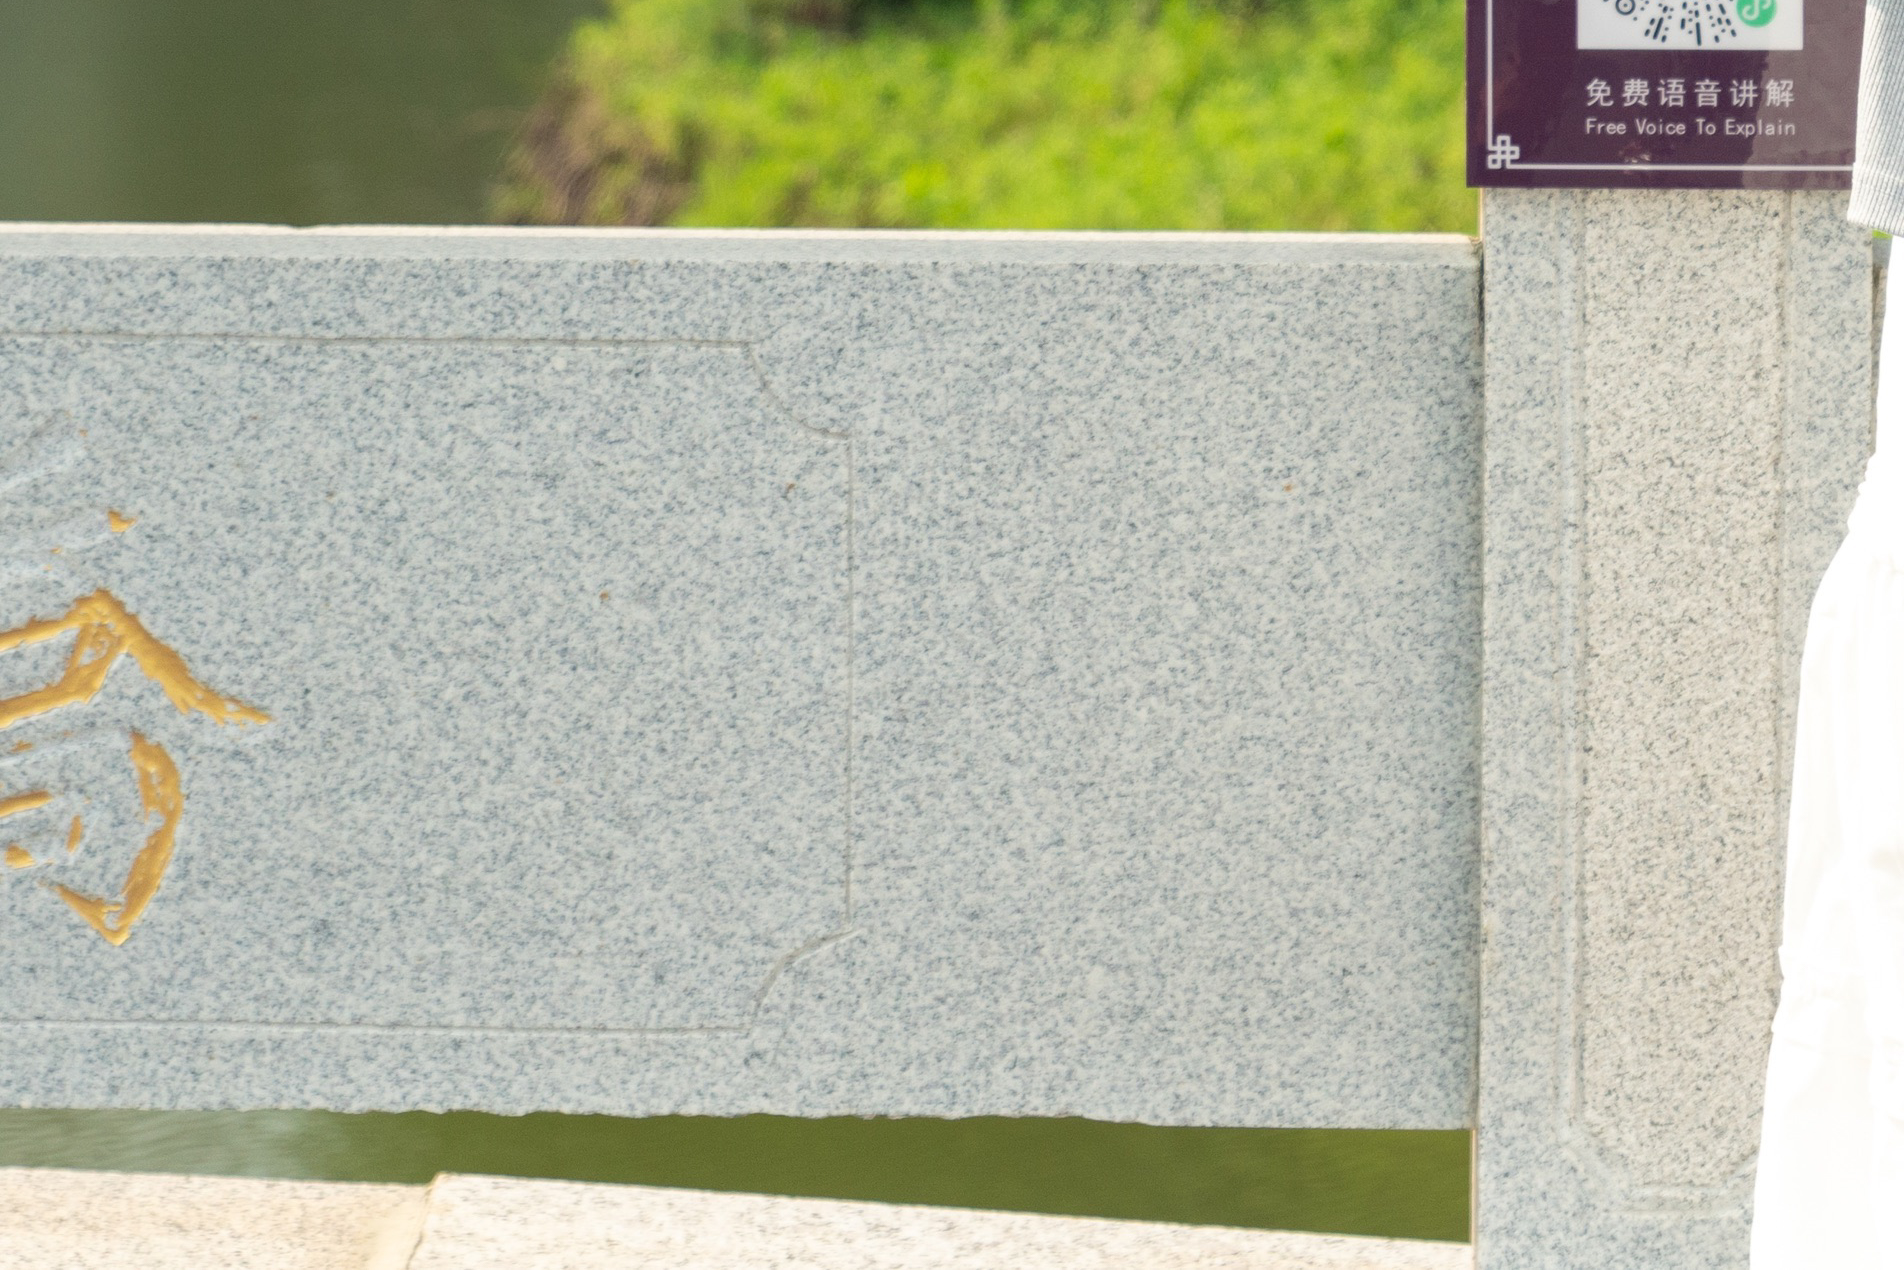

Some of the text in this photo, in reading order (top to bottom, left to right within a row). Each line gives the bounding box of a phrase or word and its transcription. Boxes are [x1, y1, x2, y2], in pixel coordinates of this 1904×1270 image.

[1585, 77, 1796, 108] 免费语音讲解
[1585, 118, 1797, 138] Free Voice To Explain
